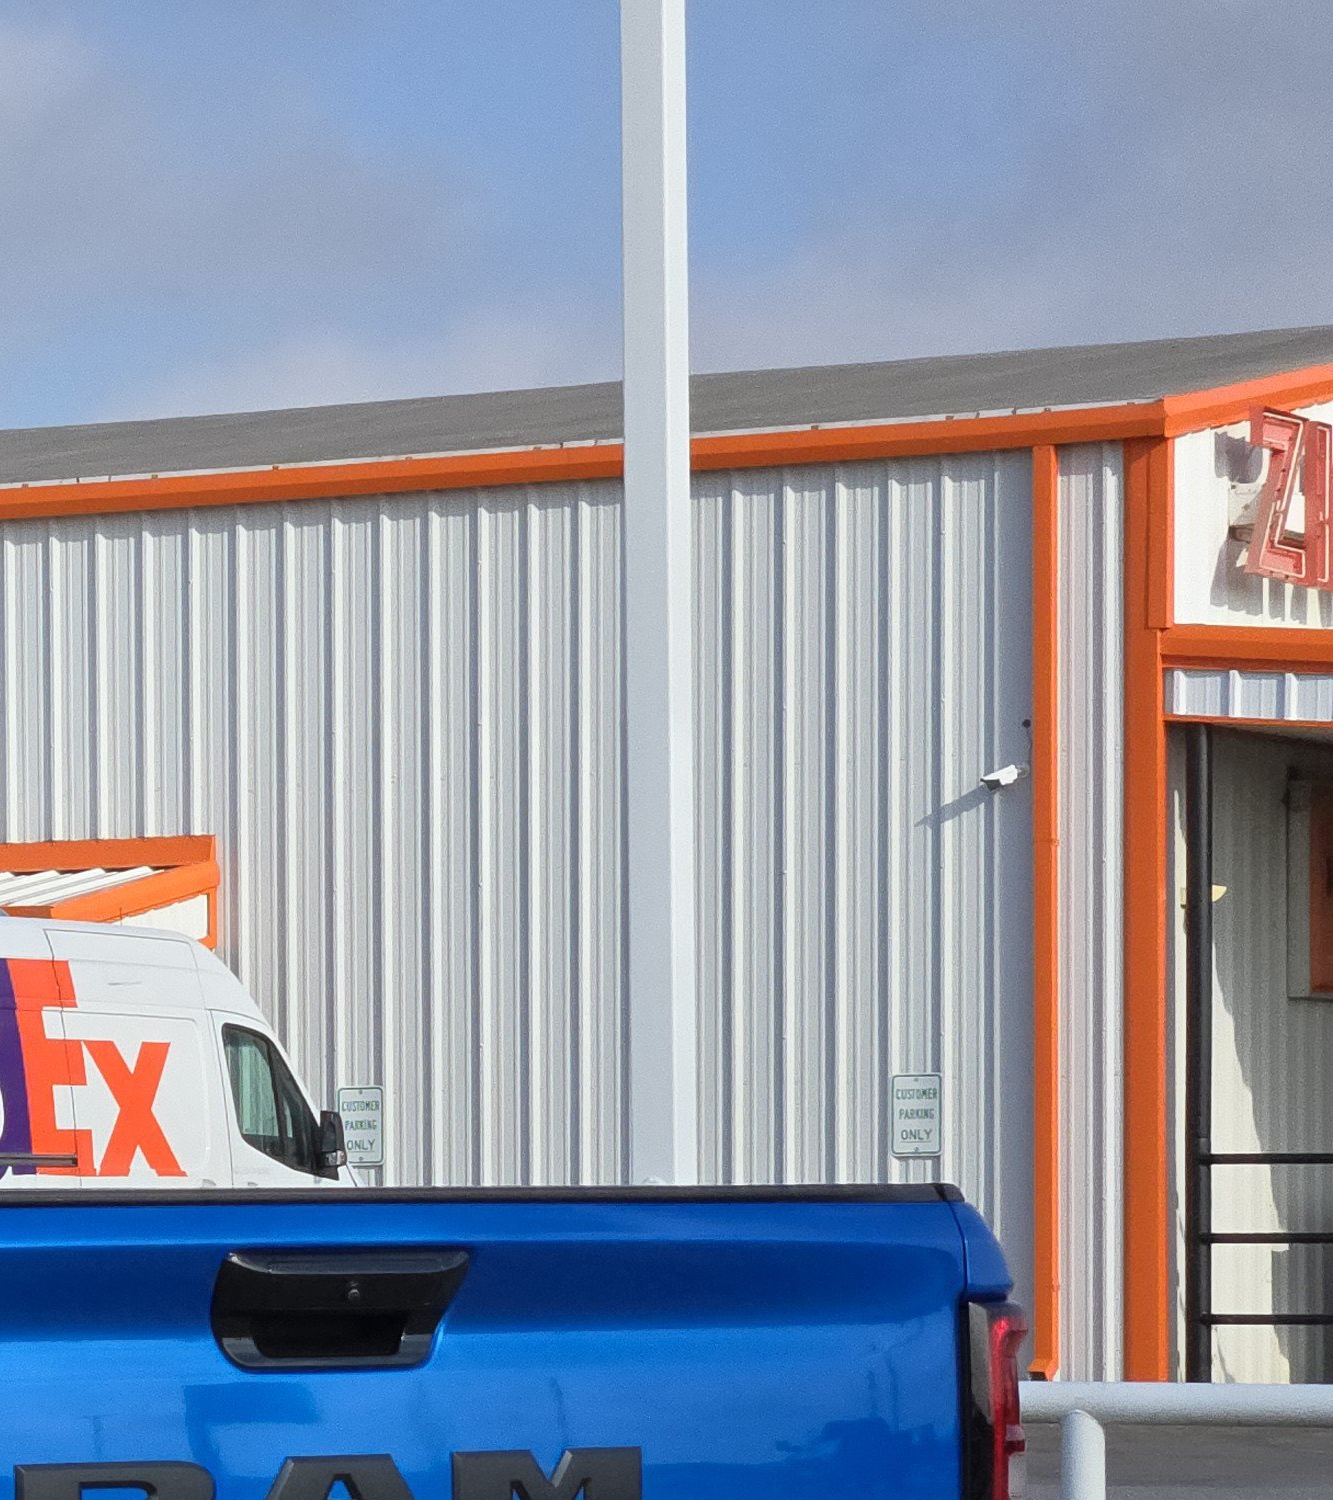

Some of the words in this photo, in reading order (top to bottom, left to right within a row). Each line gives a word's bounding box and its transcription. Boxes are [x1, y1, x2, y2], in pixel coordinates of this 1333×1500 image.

[895, 1088, 938, 1100] CUSTOMER
[341, 1100, 380, 1112] CUSTOMER
[898, 1108, 935, 1120] PARKING
[344, 1119, 377, 1131] PARKING
[900, 1129, 933, 1141] ONLY
[346, 1139, 376, 1151] ONLY
